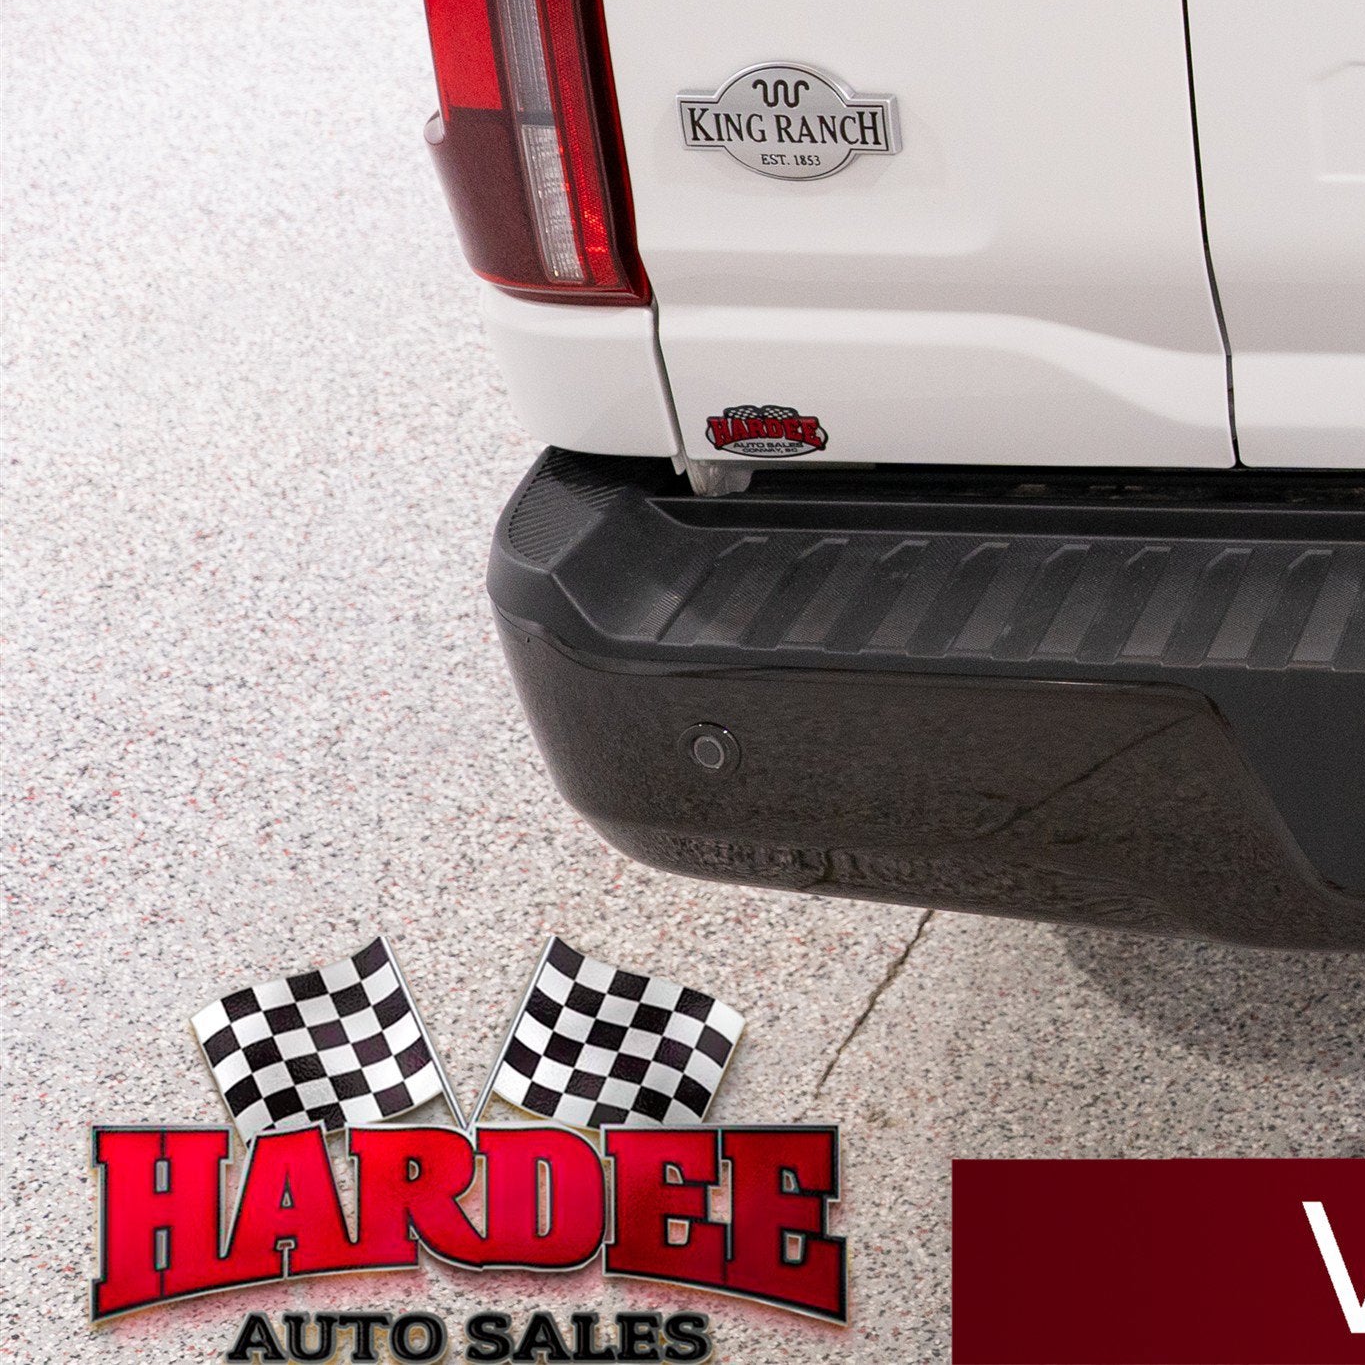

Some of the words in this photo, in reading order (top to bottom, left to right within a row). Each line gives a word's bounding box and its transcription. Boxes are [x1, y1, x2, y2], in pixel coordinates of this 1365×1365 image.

[687, 107, 768, 144] KING
[773, 110, 882, 146] RANCH
[760, 153, 791, 167] EST.
[794, 154, 822, 167] 1853
[707, 416, 826, 449] HARDEE
[733, 441, 765, 449] AUTO
[766, 441, 804, 449] SALES
